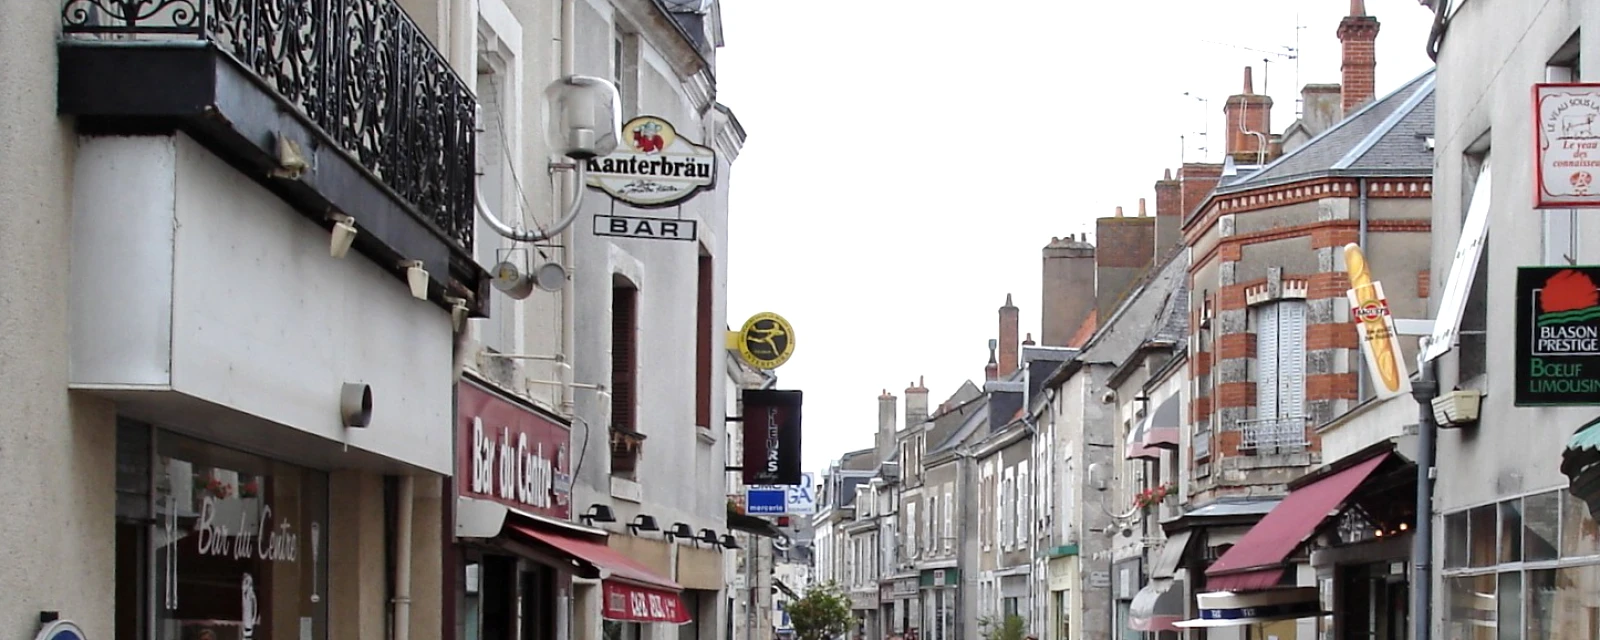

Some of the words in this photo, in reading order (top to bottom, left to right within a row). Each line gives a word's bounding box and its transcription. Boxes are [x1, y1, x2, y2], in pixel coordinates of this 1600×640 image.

[1570, 98, 1590, 107] SOUS
[1563, 140, 1575, 150] Le
[1572, 148, 1588, 159] des
[609, 218, 679, 237] BAR
[1540, 325, 1598, 339] BLASON
[1537, 338, 1600, 352] PRESTIGE
[766, 405, 780, 472] FLEURS
[473, 416, 496, 495] Bar
[500, 426, 515, 500] du
[518, 432, 552, 509] Centre
[195, 496, 230, 556] Bar
[234, 510, 253, 560] du
[258, 504, 298, 562] Centre
